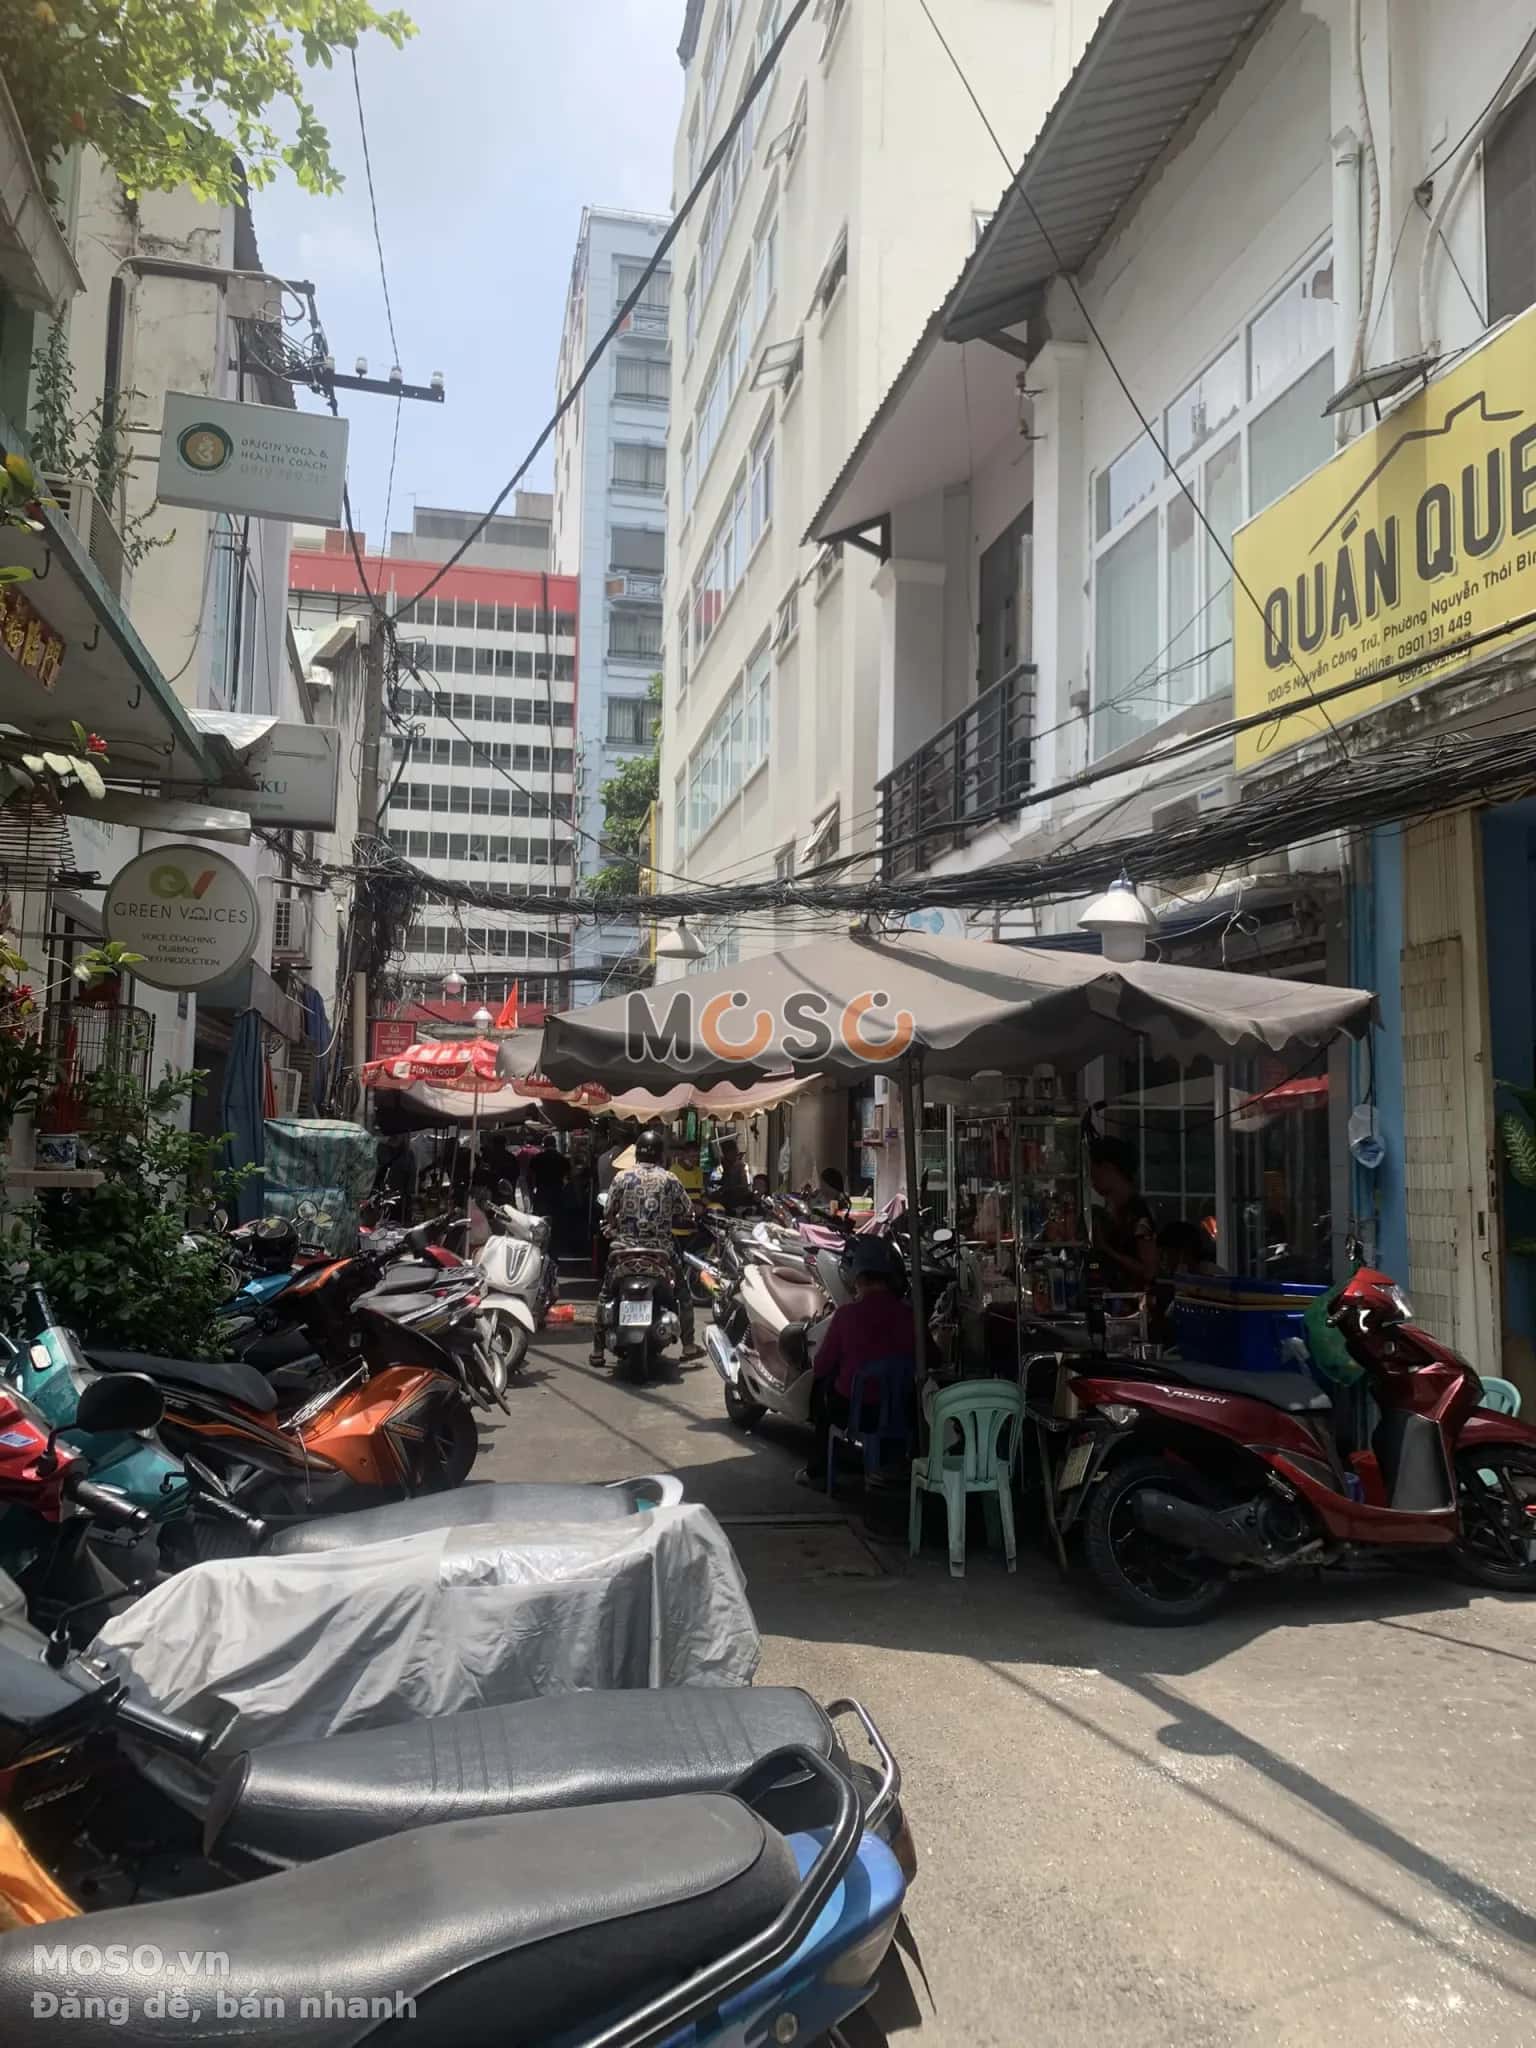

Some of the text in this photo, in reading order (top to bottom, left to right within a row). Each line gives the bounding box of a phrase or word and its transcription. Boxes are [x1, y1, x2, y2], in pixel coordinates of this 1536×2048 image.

[241, 438, 281, 451] ORIGIN
[319, 448, 329, 460] &
[241, 449, 327, 471] HEALTH COACH
[1264, 509, 1399, 672] QUÁN
[1267, 681, 1292, 705] 100/5
[1331, 647, 1358, 669] Công
[1384, 611, 1428, 642] Phường
[1431, 581, 1479, 617] Nguyễn
[1483, 560, 1512, 589] Thái
[1398, 635, 1424, 660] 0901
[1428, 624, 1445, 645] 131
[1448, 610, 1473, 633] 449
[113, 902, 248, 924] GREEN VOICES
[169, 934, 217, 945] COACHING
